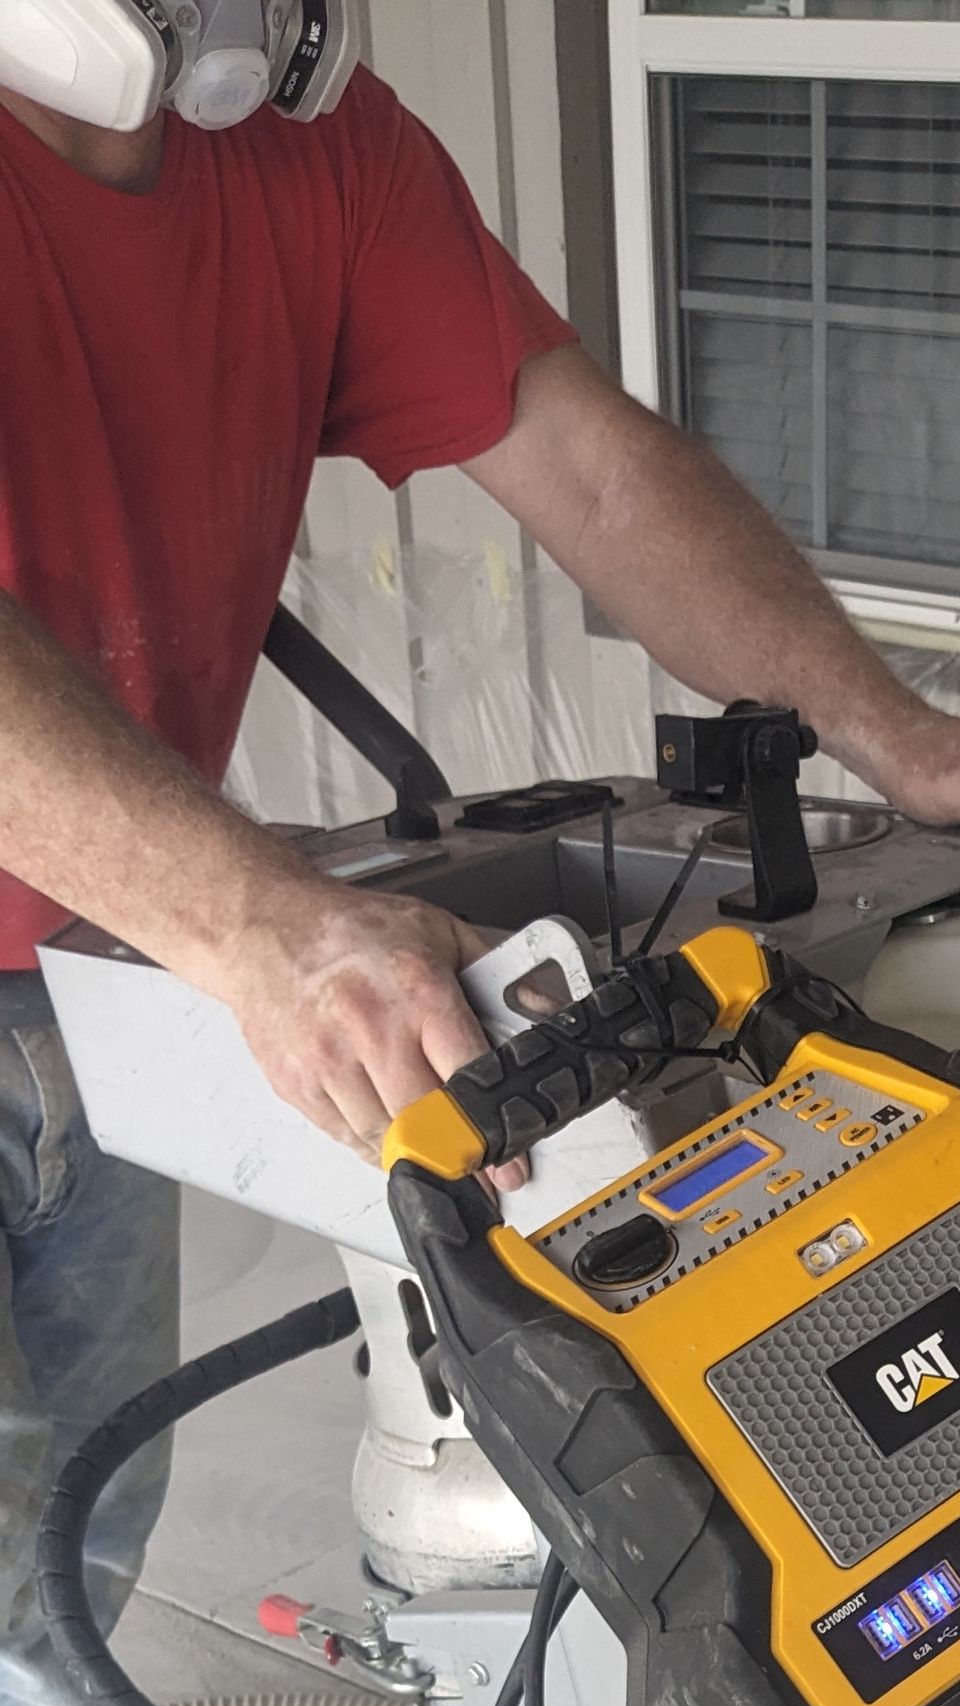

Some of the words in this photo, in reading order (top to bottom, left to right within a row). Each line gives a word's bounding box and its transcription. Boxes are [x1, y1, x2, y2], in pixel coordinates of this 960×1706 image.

[309, 21, 321, 43] 3M
[875, 1332, 960, 1413] CAT
[816, 1592, 868, 1635] CJ1000DXT
[912, 1642, 934, 1661] 6.2A
